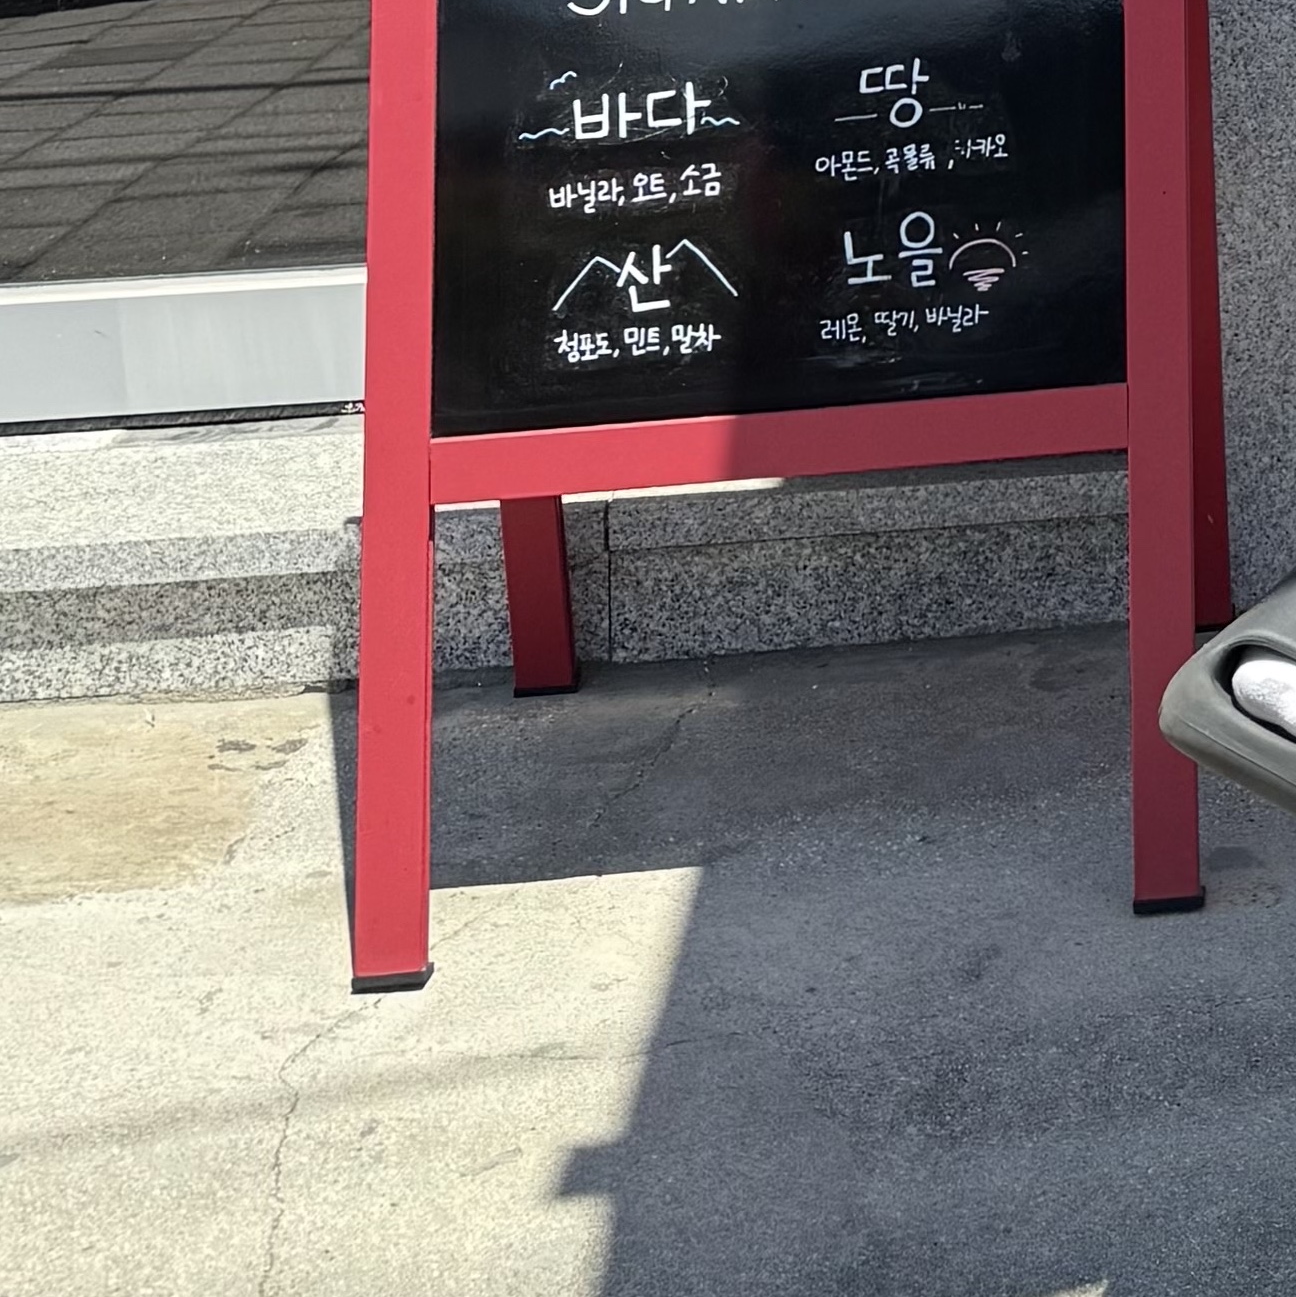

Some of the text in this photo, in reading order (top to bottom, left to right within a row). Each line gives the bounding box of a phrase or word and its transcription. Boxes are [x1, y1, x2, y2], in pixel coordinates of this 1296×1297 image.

[572, 80, 712, 141] 바다
[858, 57, 931, 129] 땅
[548, 162, 723, 215] 바닐라, 오트, 소금
[815, 149, 881, 182] 아몬드,
[843, 210, 944, 289] 노을
[615, 244, 673, 314] 산
[553, 321, 723, 364] 청포도, 민트, 말차
[818, 302, 990, 344] 레몬, 딸기, 바닐라
